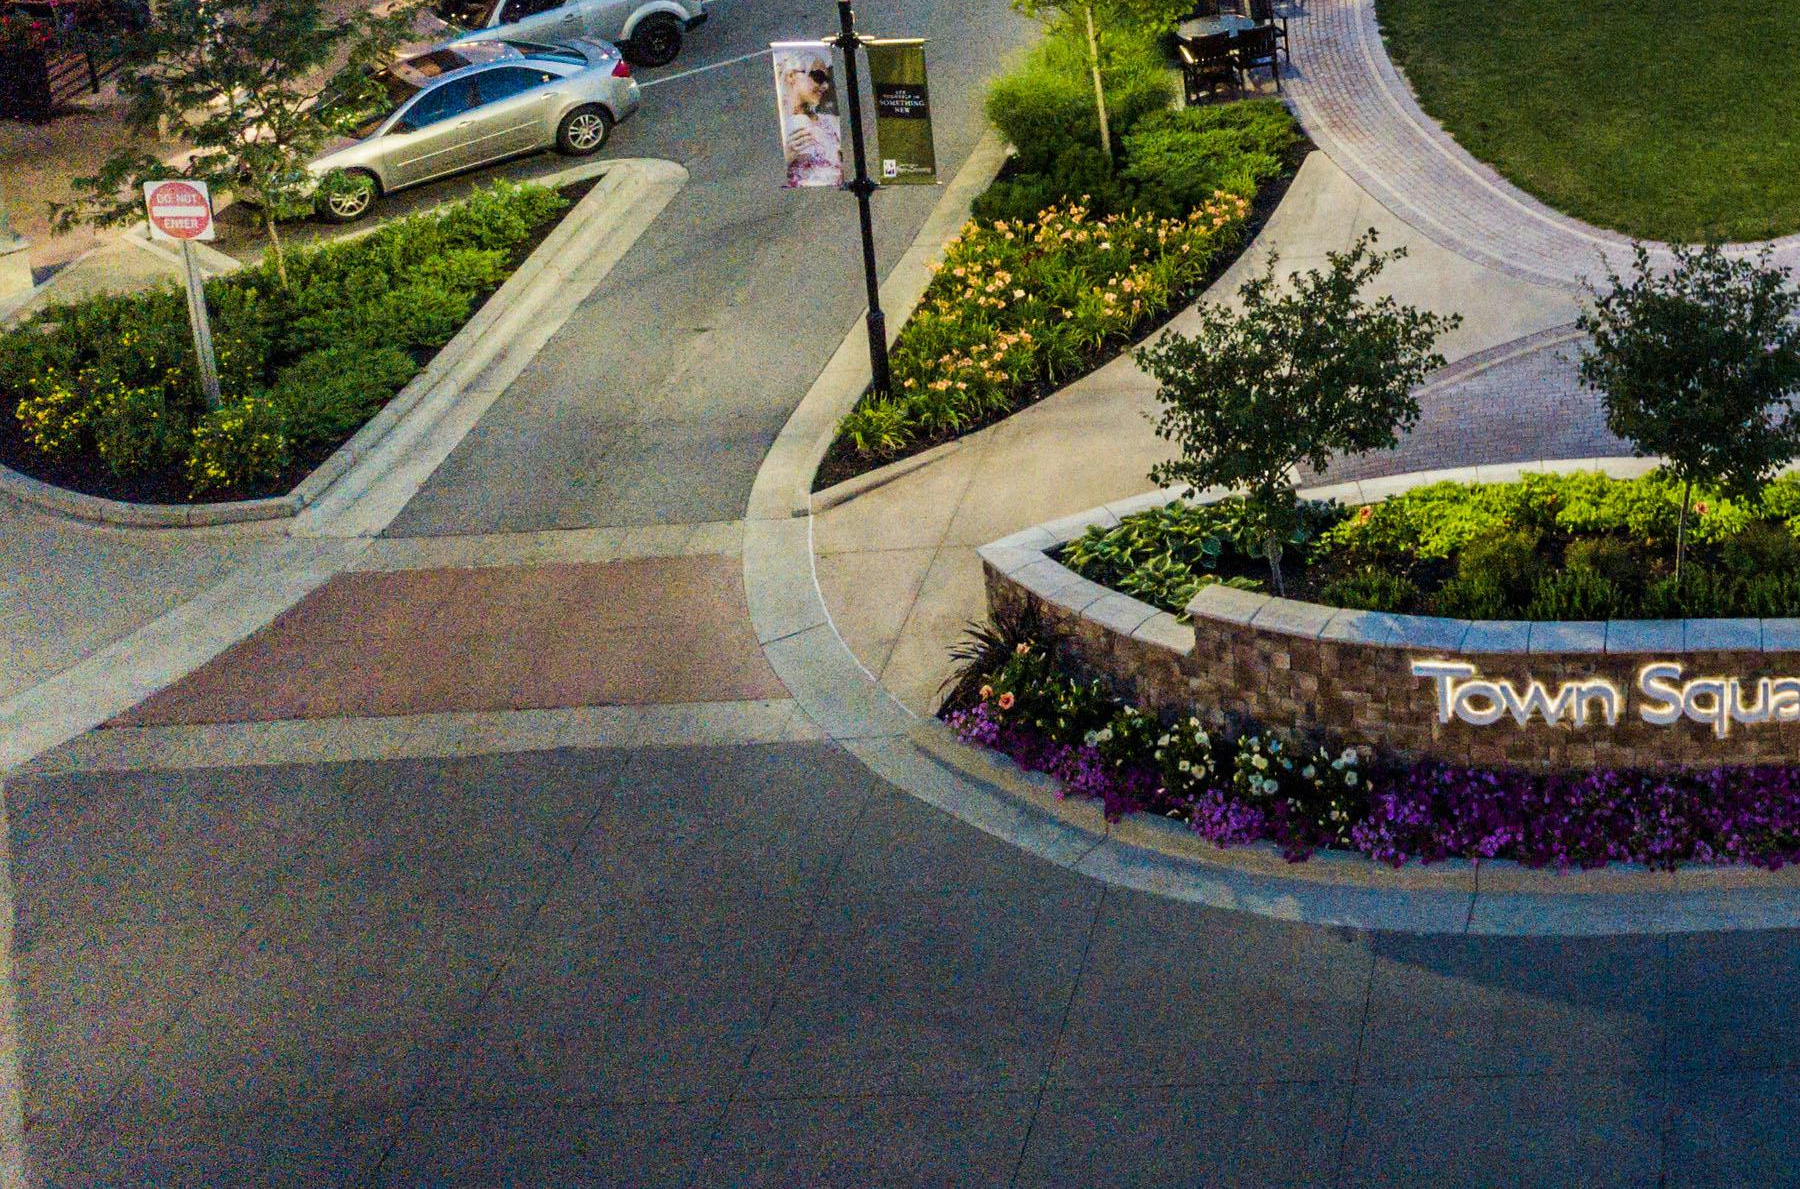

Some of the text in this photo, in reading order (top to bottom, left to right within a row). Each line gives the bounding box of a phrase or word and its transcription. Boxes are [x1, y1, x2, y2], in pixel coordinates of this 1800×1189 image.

[880, 99, 925, 107] SOMETHING
[156, 193, 198, 203] DO NOT
[164, 218, 200, 229] ENTER
[1411, 659, 1621, 728] Town
